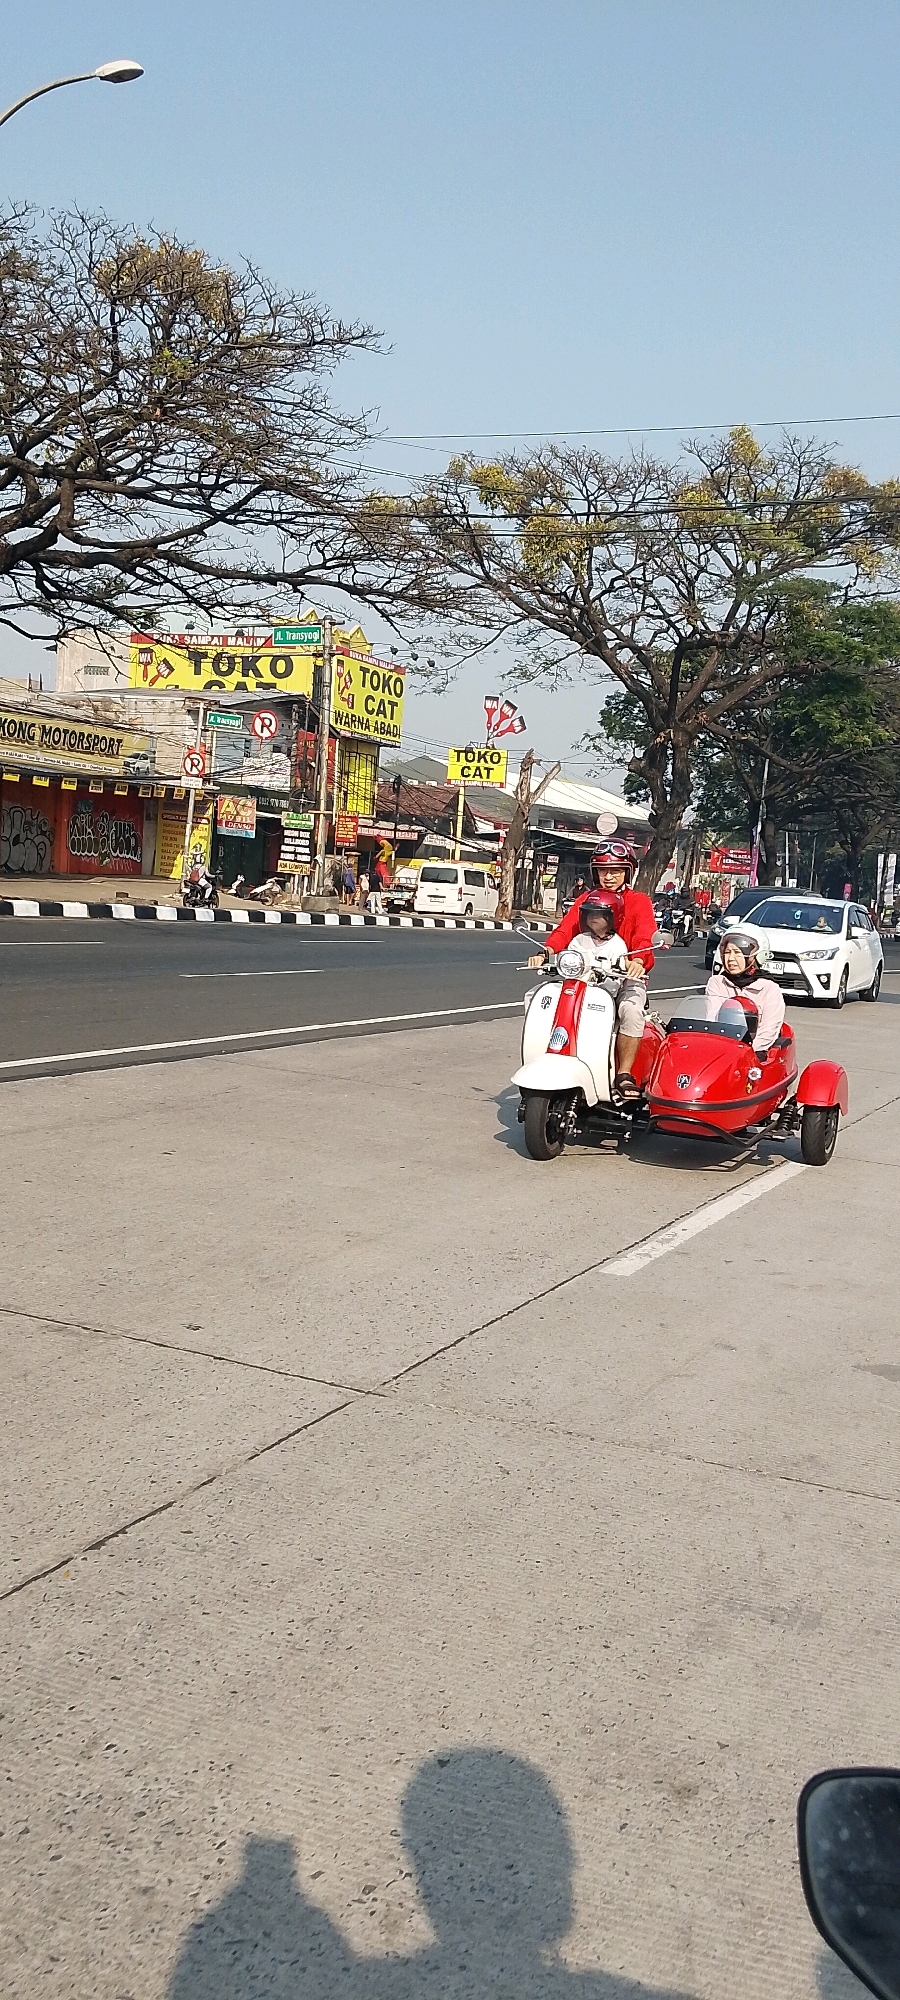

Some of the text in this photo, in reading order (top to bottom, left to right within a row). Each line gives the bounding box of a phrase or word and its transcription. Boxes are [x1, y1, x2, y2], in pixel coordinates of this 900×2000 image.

[184, 634, 222, 646] SAMPAI
[228, 636, 265, 647] MALAM
[285, 630, 320, 643] Transyogi
[188, 650, 294, 679] TOKO
[359, 665, 405, 699] TOKO
[364, 694, 399, 721] CAT
[485, 699, 498, 710] WA
[501, 703, 514, 718] WA
[260, 716, 273, 734] P
[333, 709, 371, 732] WARNA
[373, 719, 401, 740] ABADI
[40, 724, 124, 756] MOTORSPORT
[453, 749, 502, 765] TOKO
[460, 765, 495, 780] CAT
[220, 799, 254, 817] AC
[219, 813, 251, 824] MOBIL
[227, 822, 251, 830] DENSO
